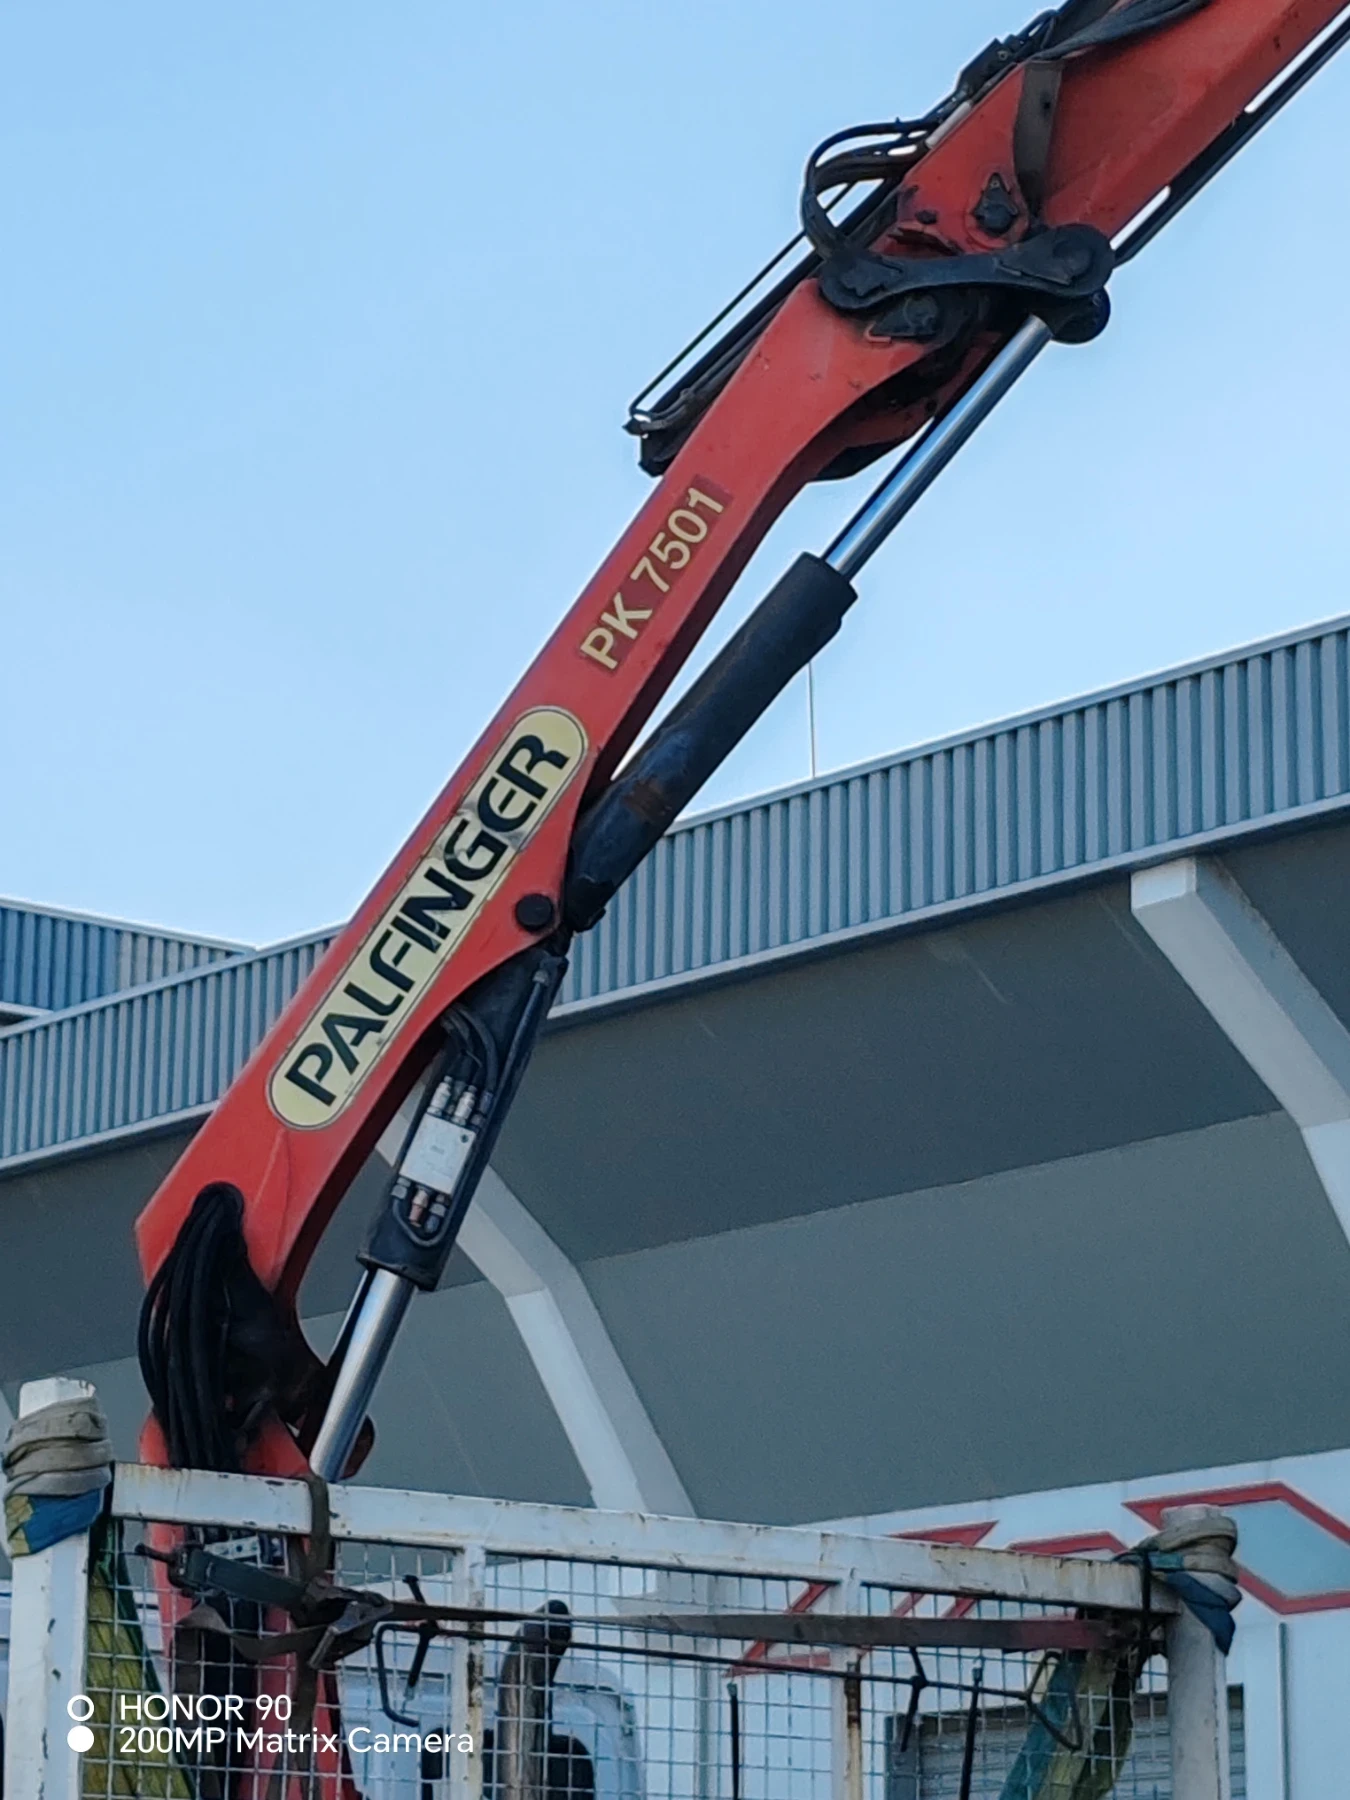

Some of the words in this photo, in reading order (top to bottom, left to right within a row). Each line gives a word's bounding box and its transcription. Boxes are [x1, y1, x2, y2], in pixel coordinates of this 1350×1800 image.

[580, 592, 653, 670] PK
[630, 487, 724, 593] 7501
[285, 734, 569, 1107] PALFINGER
